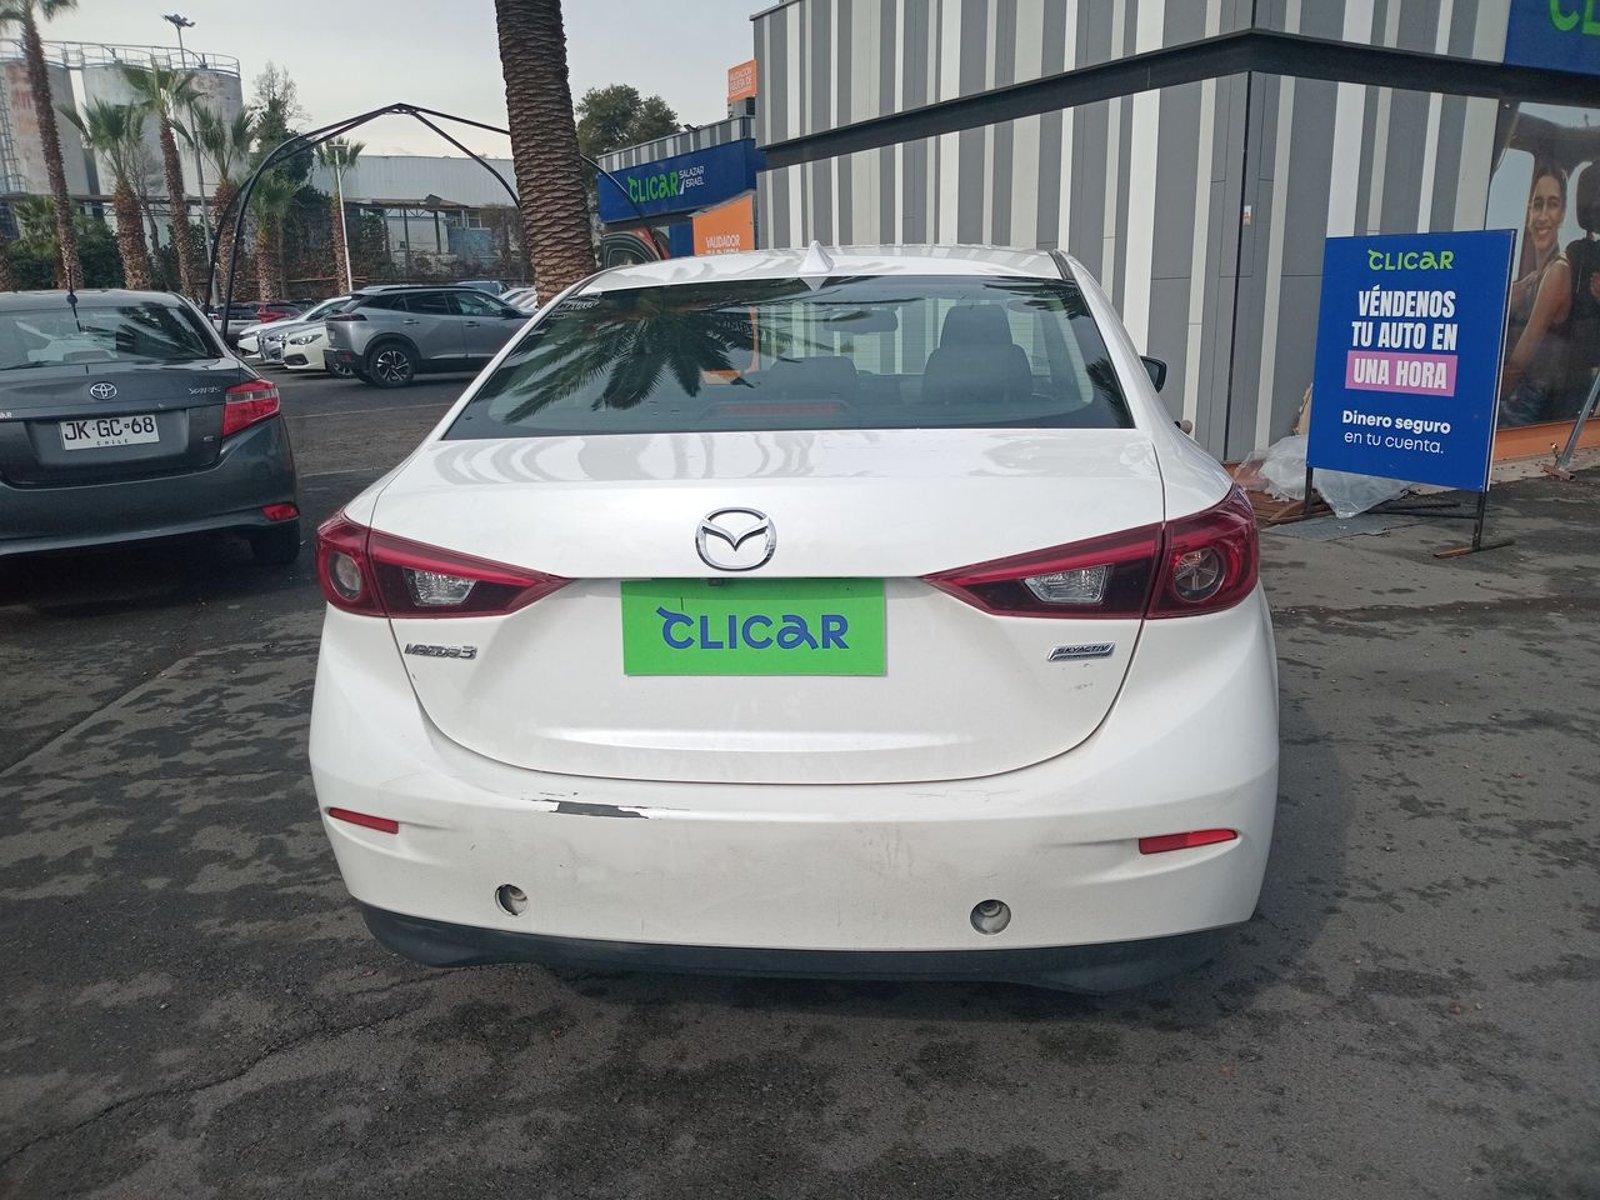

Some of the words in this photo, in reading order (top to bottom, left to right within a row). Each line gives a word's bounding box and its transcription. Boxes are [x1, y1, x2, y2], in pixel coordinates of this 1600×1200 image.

[1358, 285, 1456, 318] VÉNDENOS
[1352, 321, 1372, 347] TU
[1378, 322, 1426, 350] AUTO
[1432, 324, 1458, 350] EN
[1354, 358, 1389, 386] UNA
[1396, 360, 1446, 389] HORA
[1342, 410, 1392, 429] Dinero
[1395, 417, 1451, 437] seguro
[1344, 432, 1362, 444] en
[1366, 433, 1380, 446] tu
[1384, 436, 1444, 454] cuenta.
